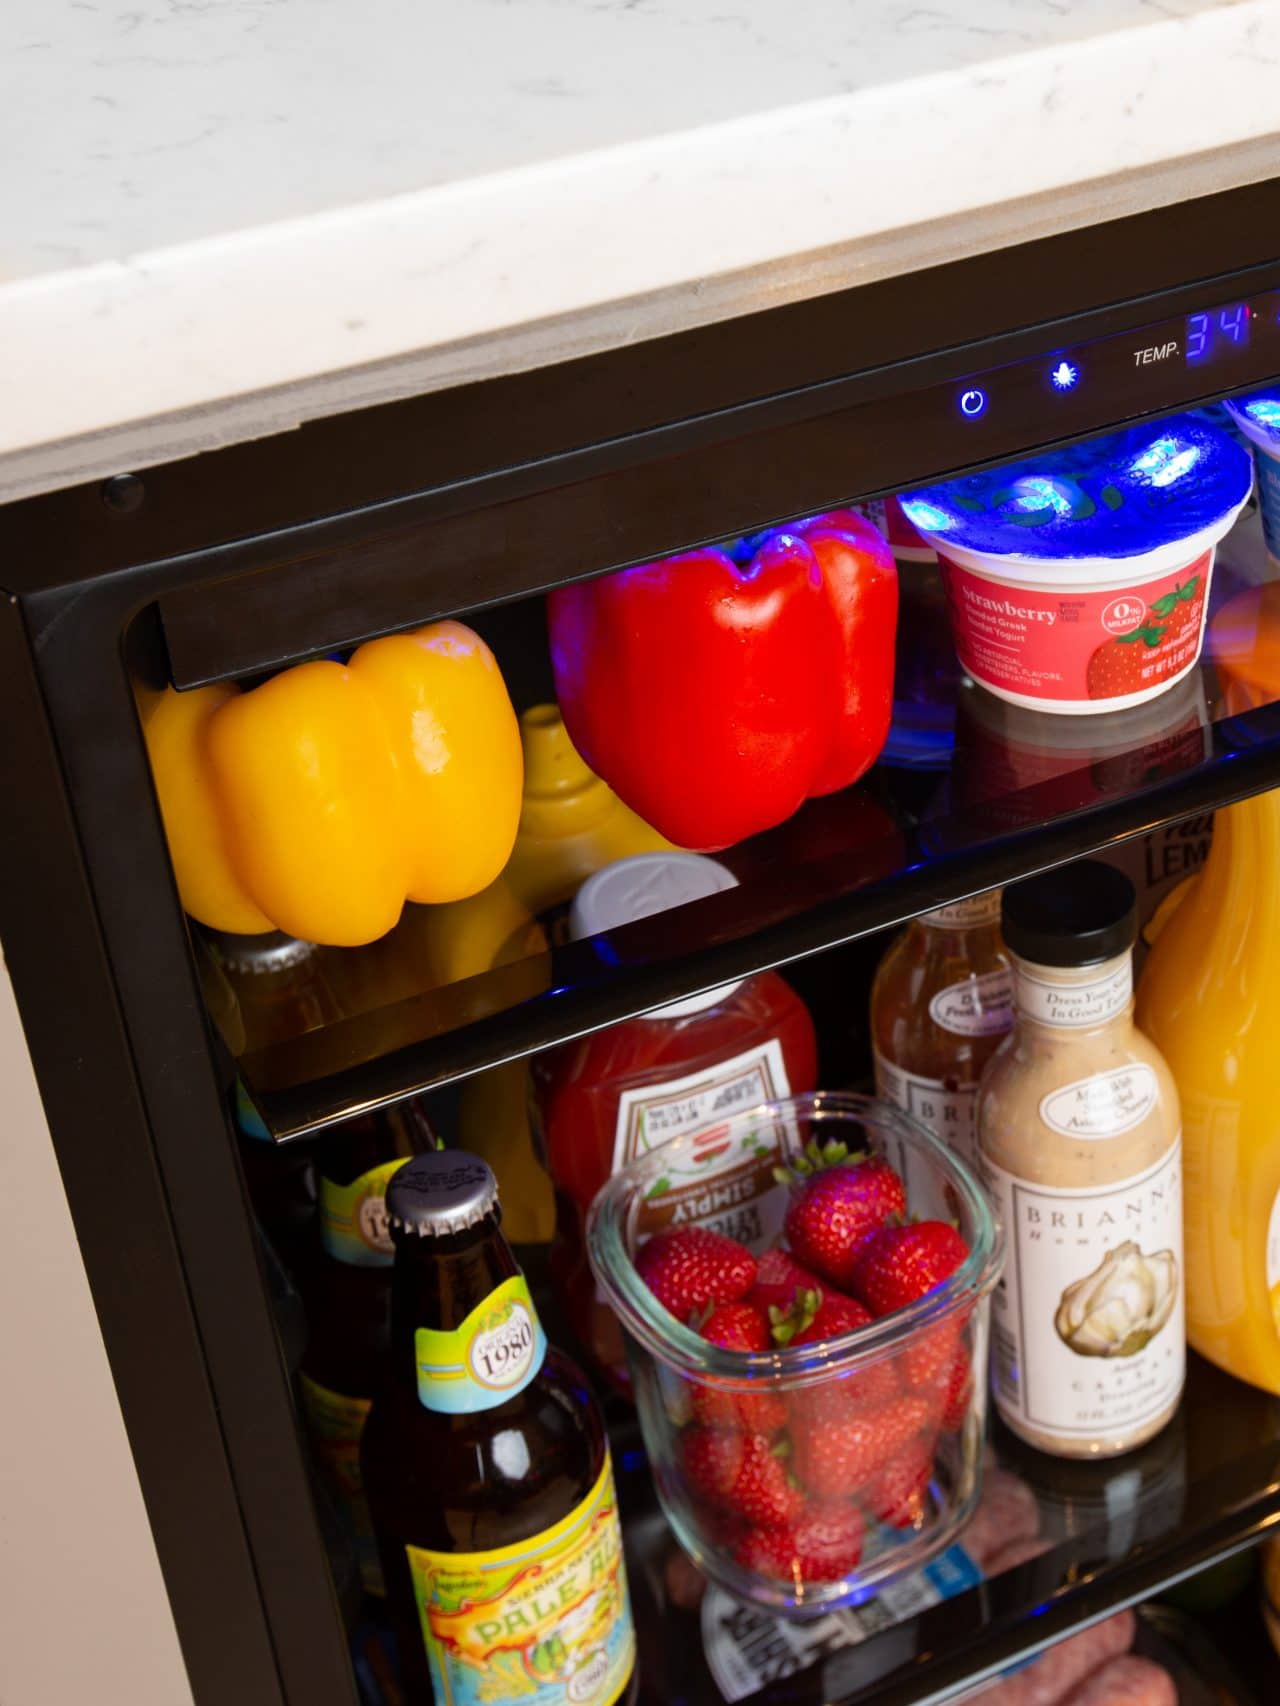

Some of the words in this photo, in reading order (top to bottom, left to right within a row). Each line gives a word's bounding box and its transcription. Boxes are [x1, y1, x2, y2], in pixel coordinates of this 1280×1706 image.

[1134, 342, 1180, 366] TEMP.
[1186, 306, 1242, 358] 34
[962, 586, 1057, 626] Strawberry
[1113, 602, 1141, 618] 0%
[671, 1177, 757, 1224] SIMPLY
[481, 1321, 532, 1377] 1980
[475, 1577, 582, 1645] PALE
